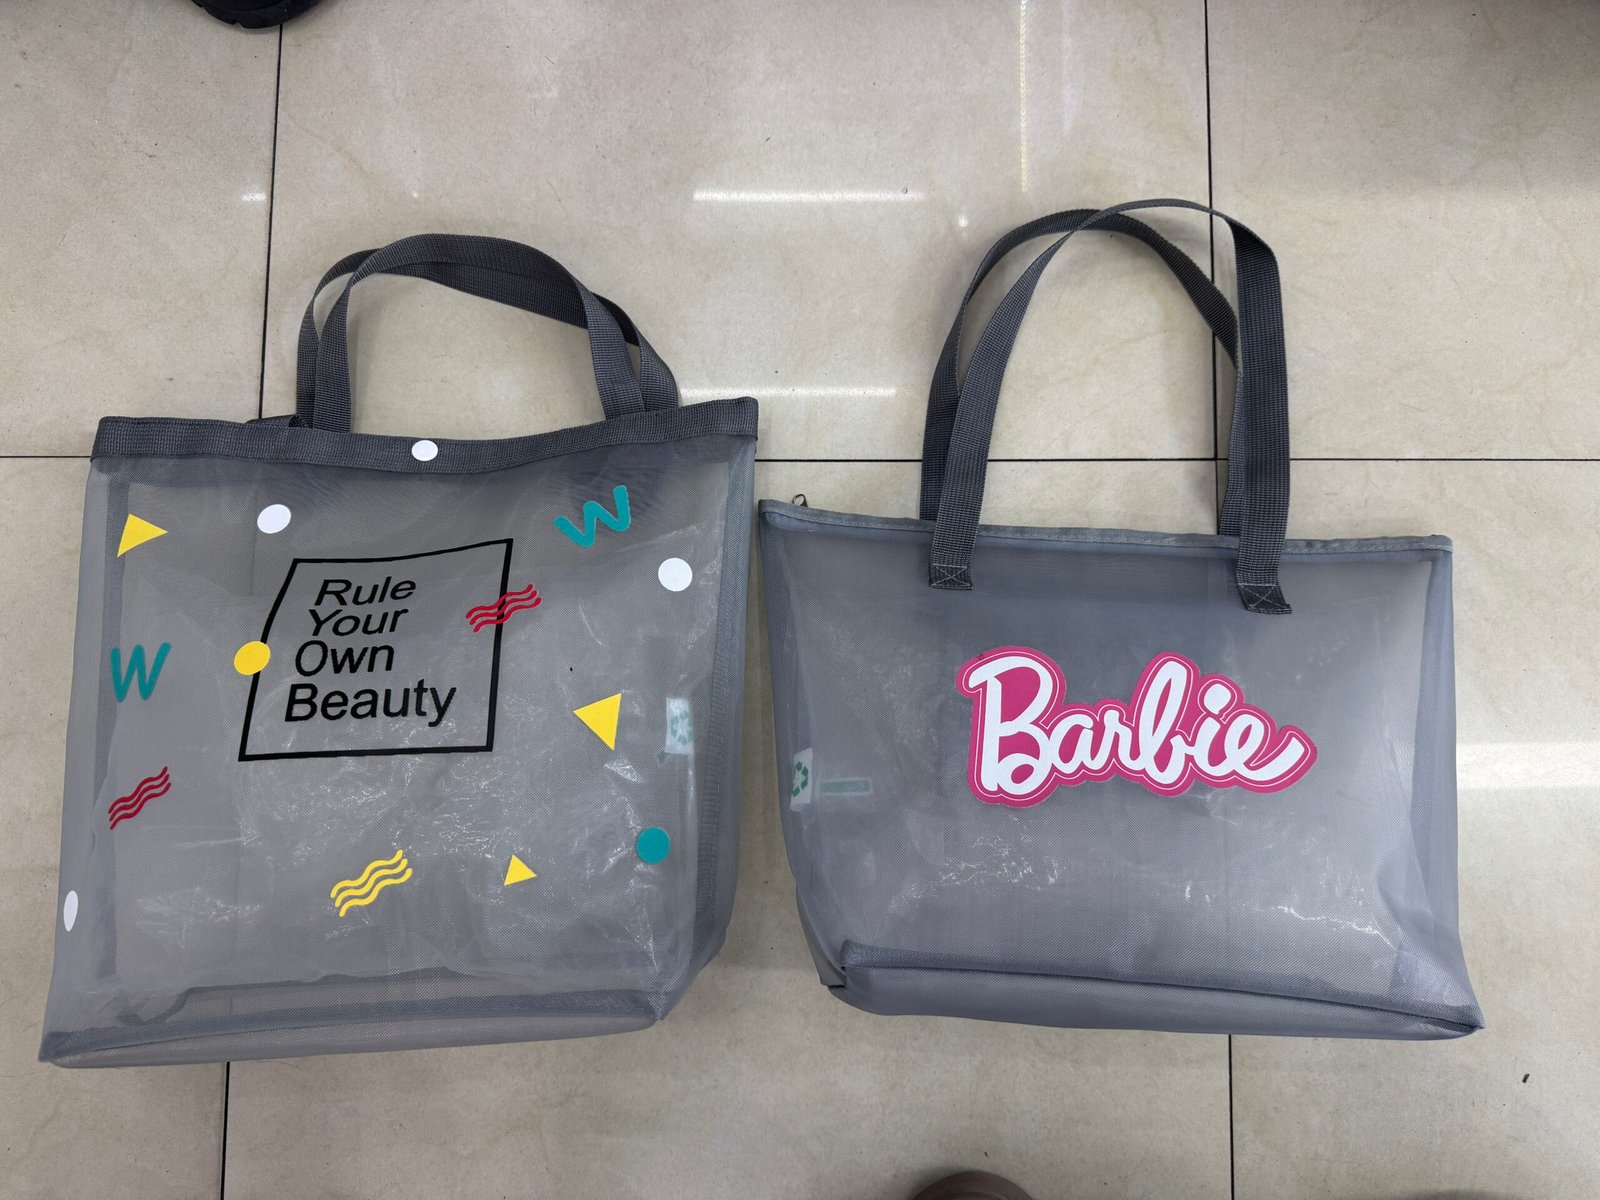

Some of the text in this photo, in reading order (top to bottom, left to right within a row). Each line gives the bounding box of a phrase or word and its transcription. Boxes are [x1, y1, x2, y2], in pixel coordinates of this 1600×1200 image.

[314, 576, 417, 607] Rule
[308, 608, 410, 637] Your
[295, 640, 395, 677] Own
[284, 678, 457, 728] Beauty
[967, 655, 1305, 796] Barbie
